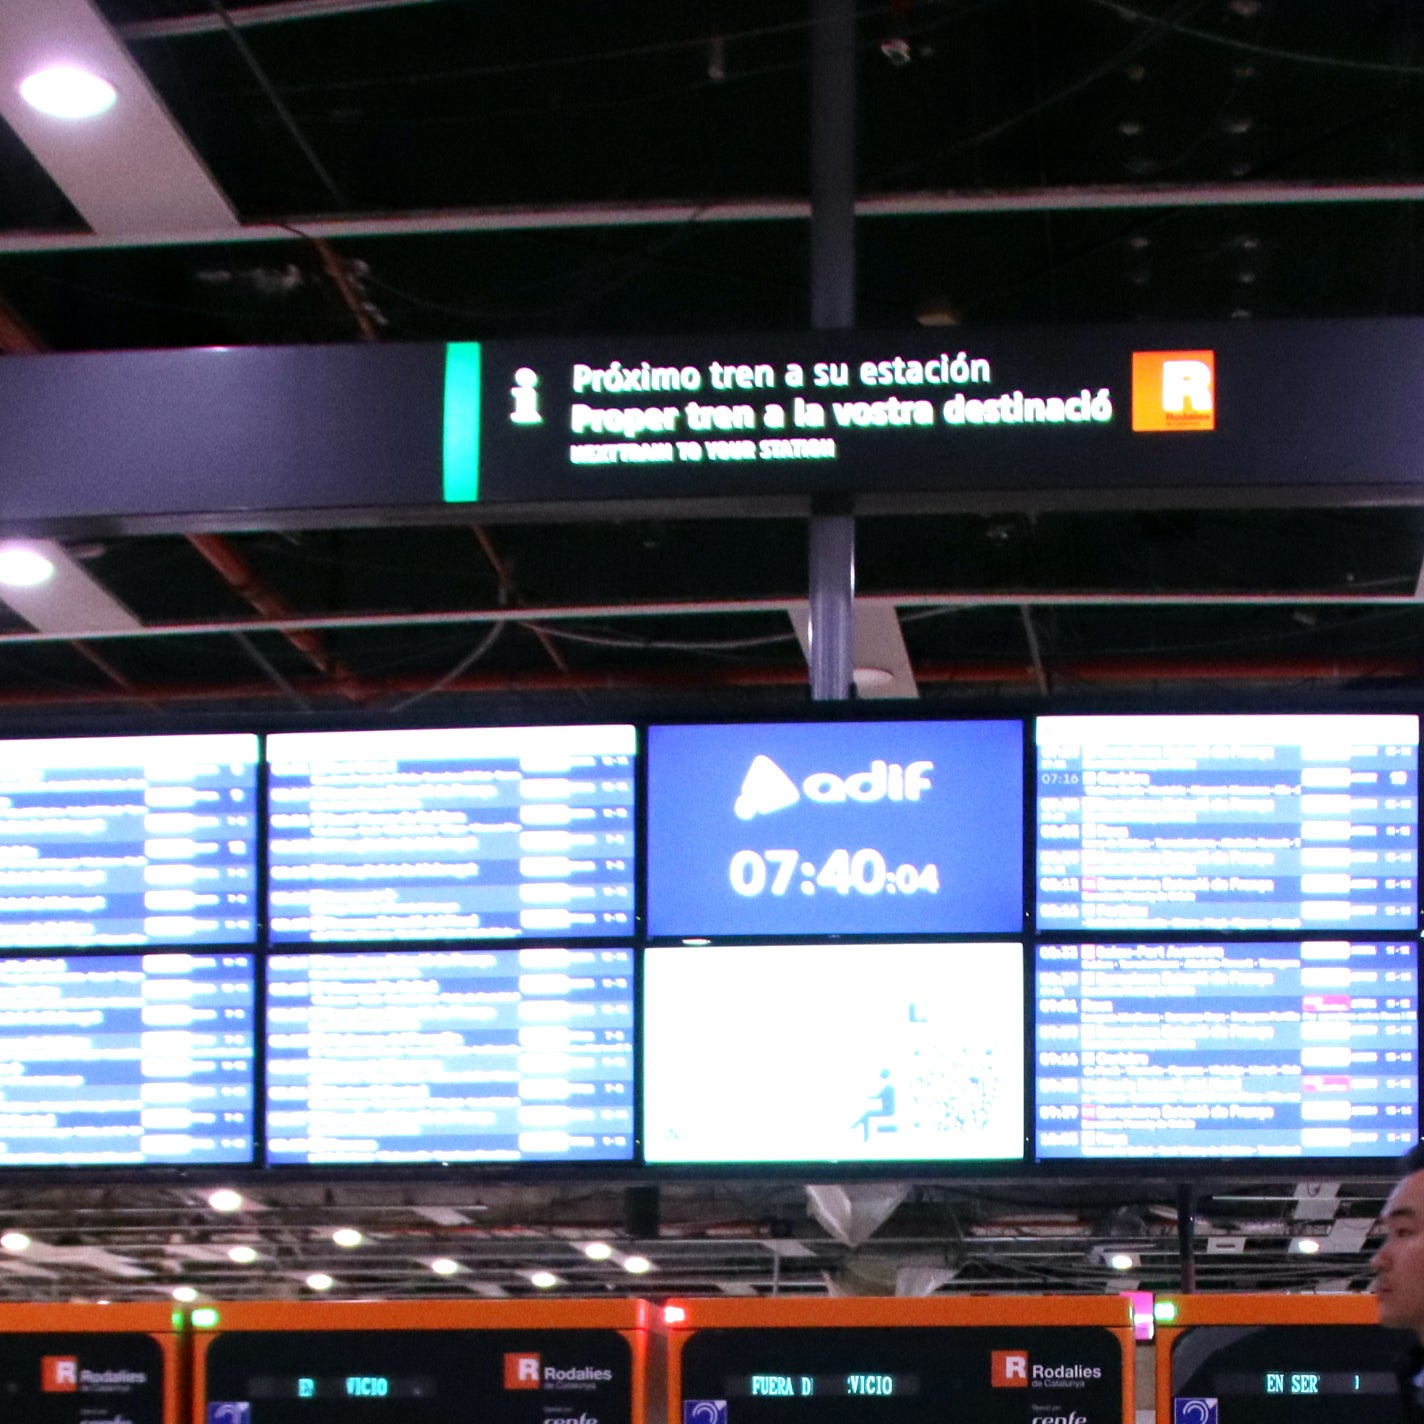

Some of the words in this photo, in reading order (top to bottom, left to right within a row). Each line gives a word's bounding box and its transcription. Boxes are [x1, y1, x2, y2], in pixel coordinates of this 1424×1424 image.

[573, 361, 701, 393] Próximo
[709, 361, 775, 389] tren
[784, 363, 804, 388] a
[813, 362, 849, 387] su
[859, 351, 991, 386] estación
[1162, 360, 1213, 411] R
[571, 403, 681, 438] Proper
[685, 401, 756, 431] tren
[763, 404, 785, 429] a
[794, 397, 826, 428] la
[832, 396, 934, 427] vostra
[942, 388, 1113, 425] destinació
[802, 760, 935, 803] adif
[1041, 773, 1079, 785] 07:16
[729, 848, 940, 897] 07:40:04
[518, 1358, 539, 1381] R
[544, 1366, 613, 1381] Rodalies
[1005, 1356, 1026, 1379] R
[1032, 1364, 1102, 1379] Rodalies
[1266, 1373, 1284, 1393] EN
[751, 1375, 794, 1396] FUERA
